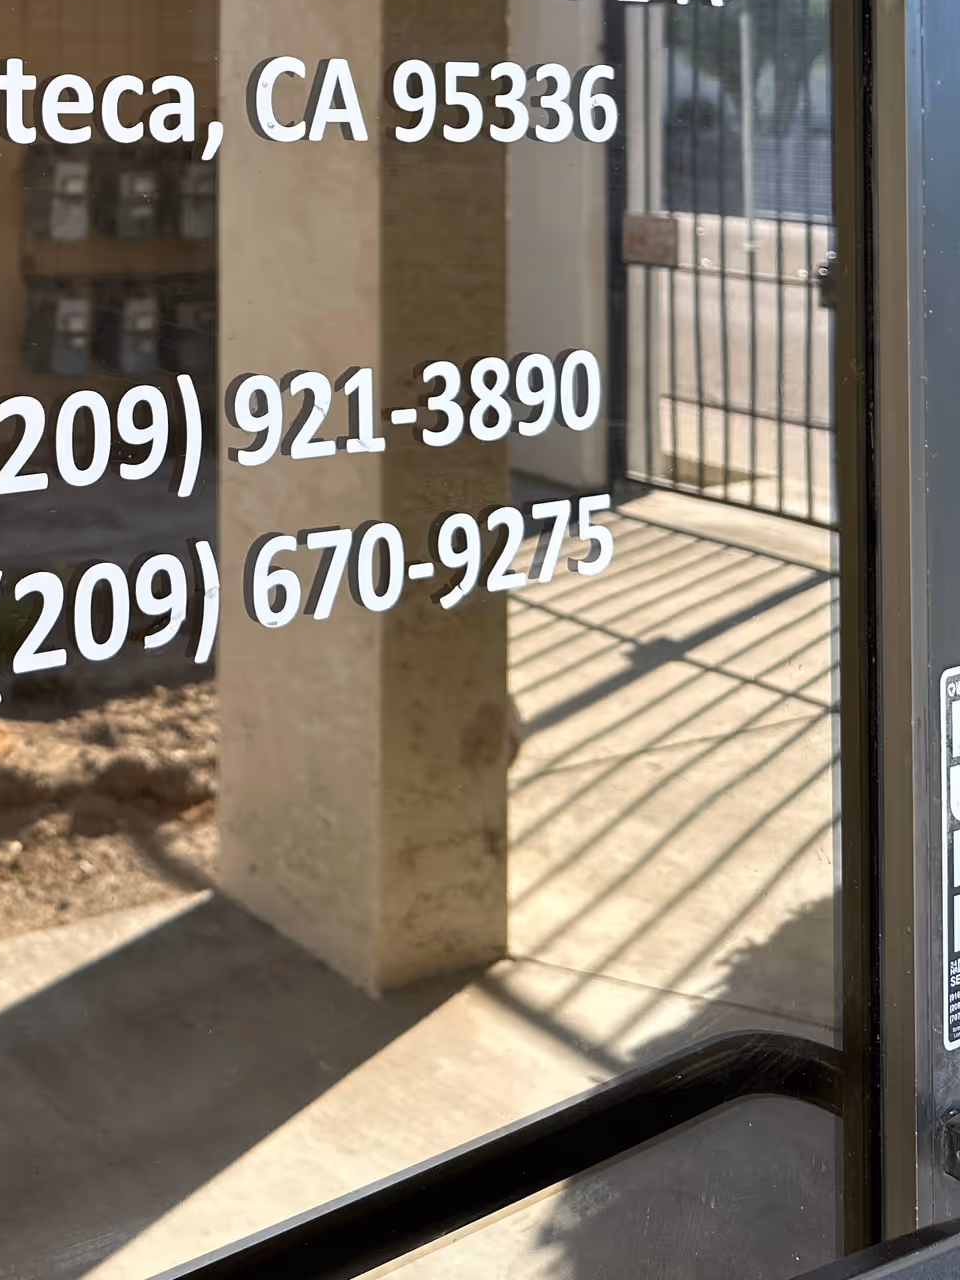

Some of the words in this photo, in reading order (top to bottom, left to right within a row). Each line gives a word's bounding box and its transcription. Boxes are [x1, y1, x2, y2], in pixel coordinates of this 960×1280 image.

[255, 56, 368, 142] CA
[393, 59, 617, 143] 95336
[234, 349, 600, 466] 921-3890
[253, 493, 614, 628] 670-9275
